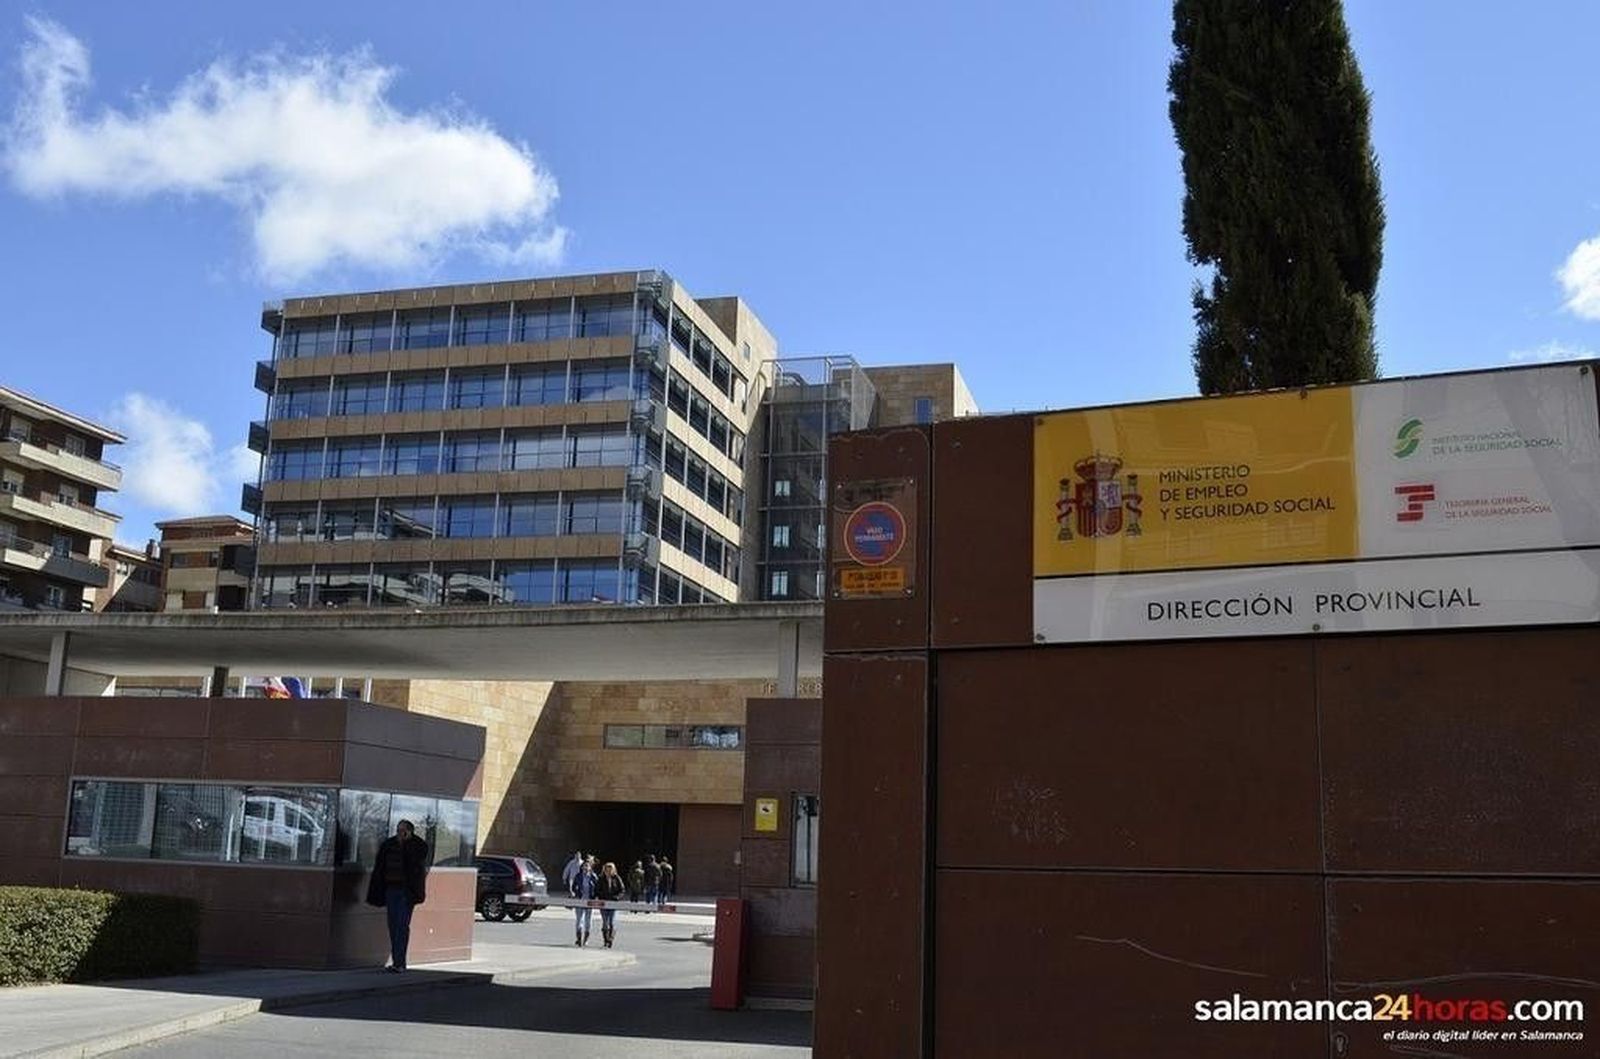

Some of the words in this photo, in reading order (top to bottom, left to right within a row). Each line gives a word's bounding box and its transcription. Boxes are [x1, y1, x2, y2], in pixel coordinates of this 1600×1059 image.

[1464, 440, 1522, 453] SEGURIDAD
[1524, 437, 1562, 449] SOCIAL
[1159, 464, 1250, 483] MINISTERIO
[1160, 488, 1180, 502] DE
[1186, 484, 1248, 500] EMPLEO
[1160, 507, 1170, 520] Y
[1175, 502, 1269, 520] SEGURIDAD
[1274, 497, 1336, 514] SOCIAL
[1521, 504, 1552, 514] SOCIAL
[1148, 593, 1293, 621] DIRECCIÓN
[1316, 587, 1481, 613] PROVINCIAL
